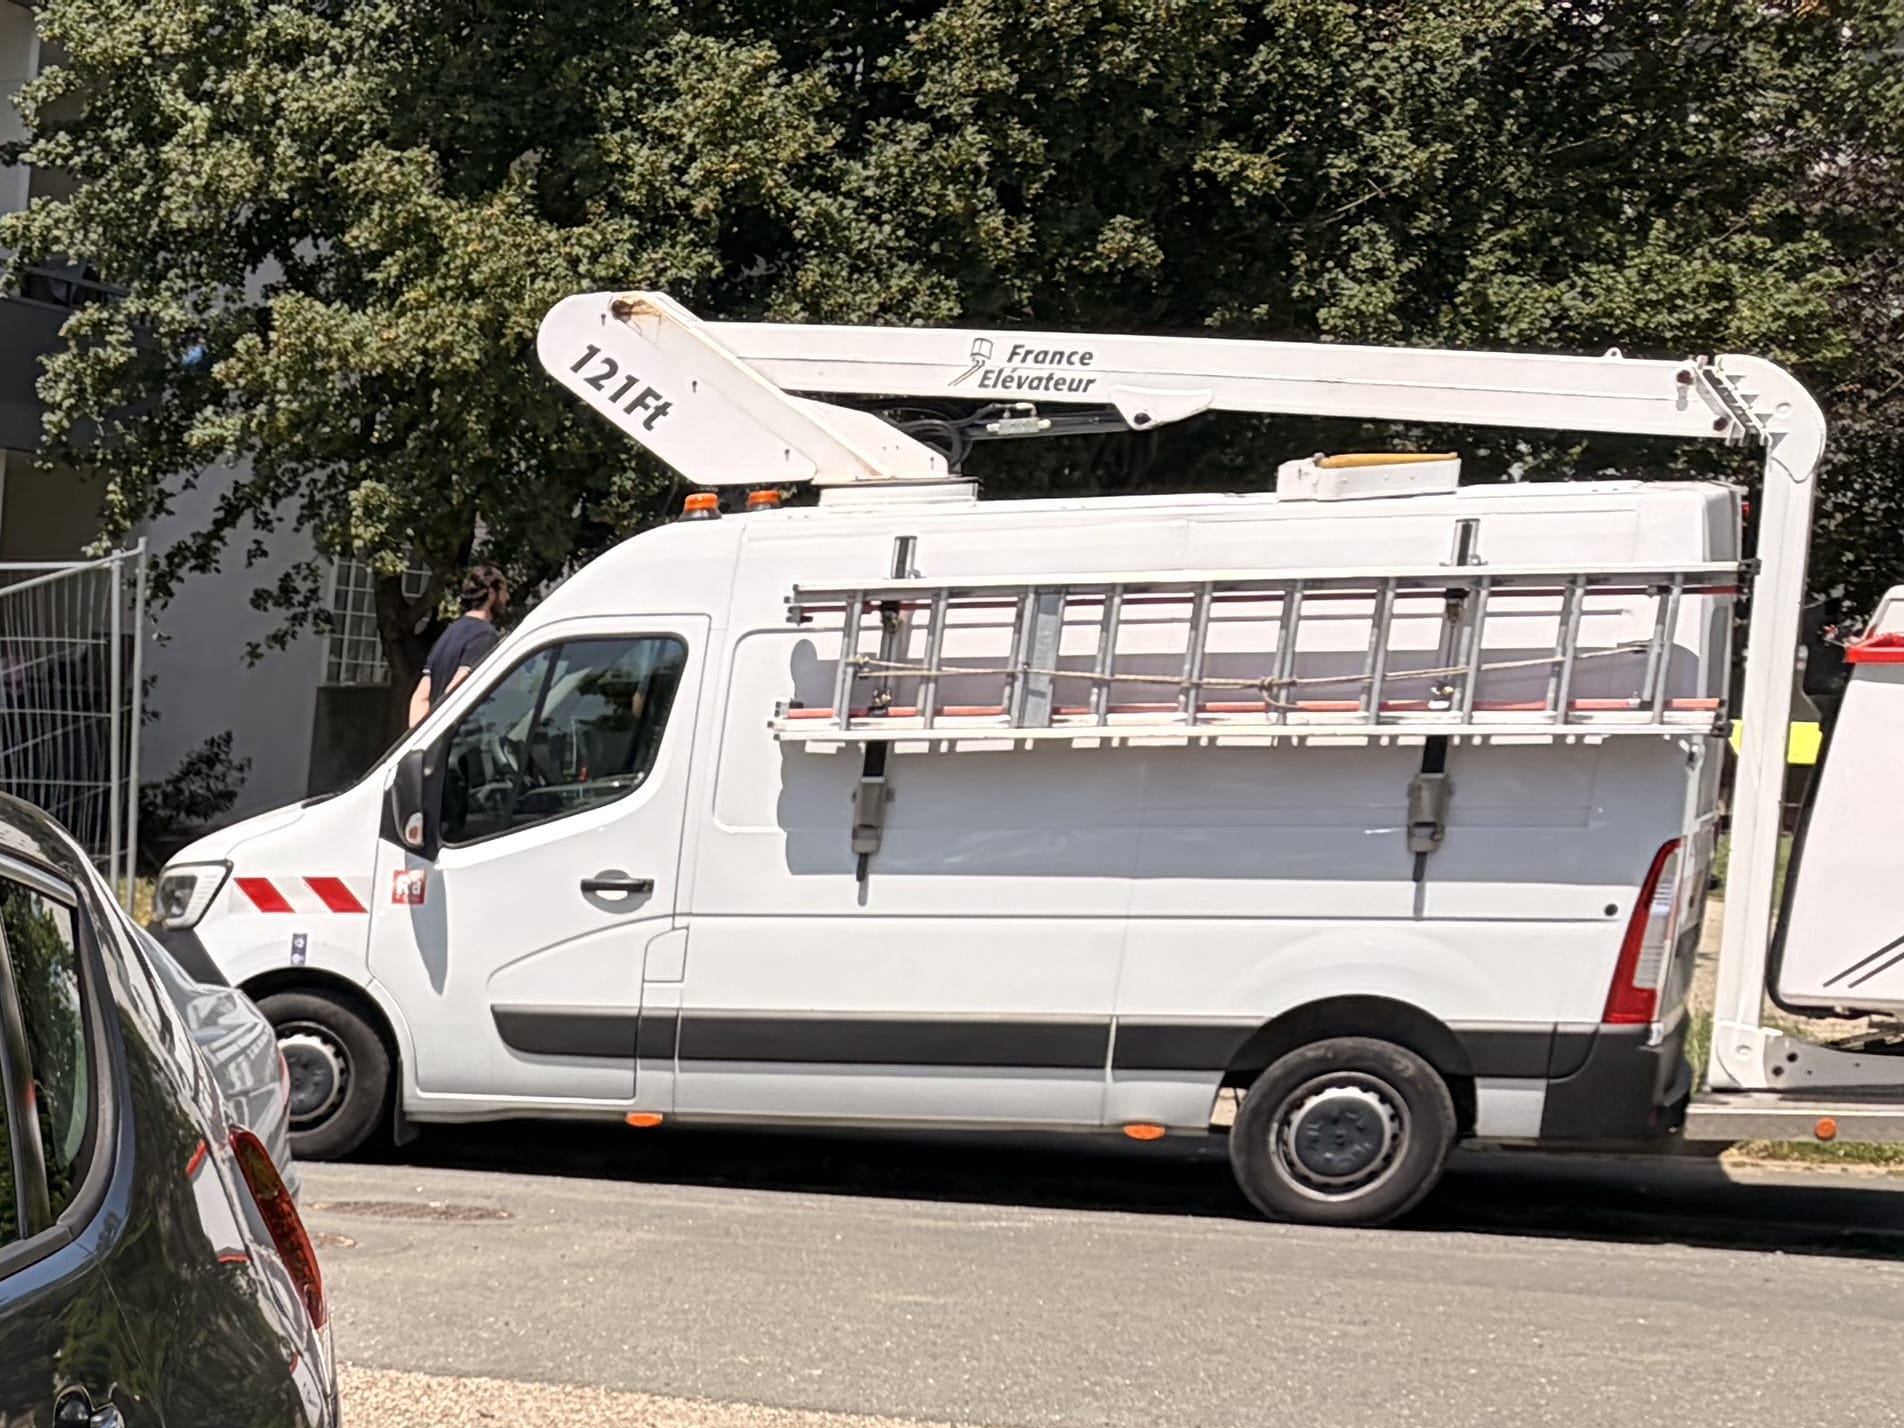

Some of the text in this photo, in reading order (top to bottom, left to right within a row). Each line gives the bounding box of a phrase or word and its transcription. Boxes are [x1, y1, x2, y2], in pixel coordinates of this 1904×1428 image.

[1007, 344, 1093, 366] France
[570, 344, 674, 431] 121Ft
[978, 367, 1096, 393] Elévateur
